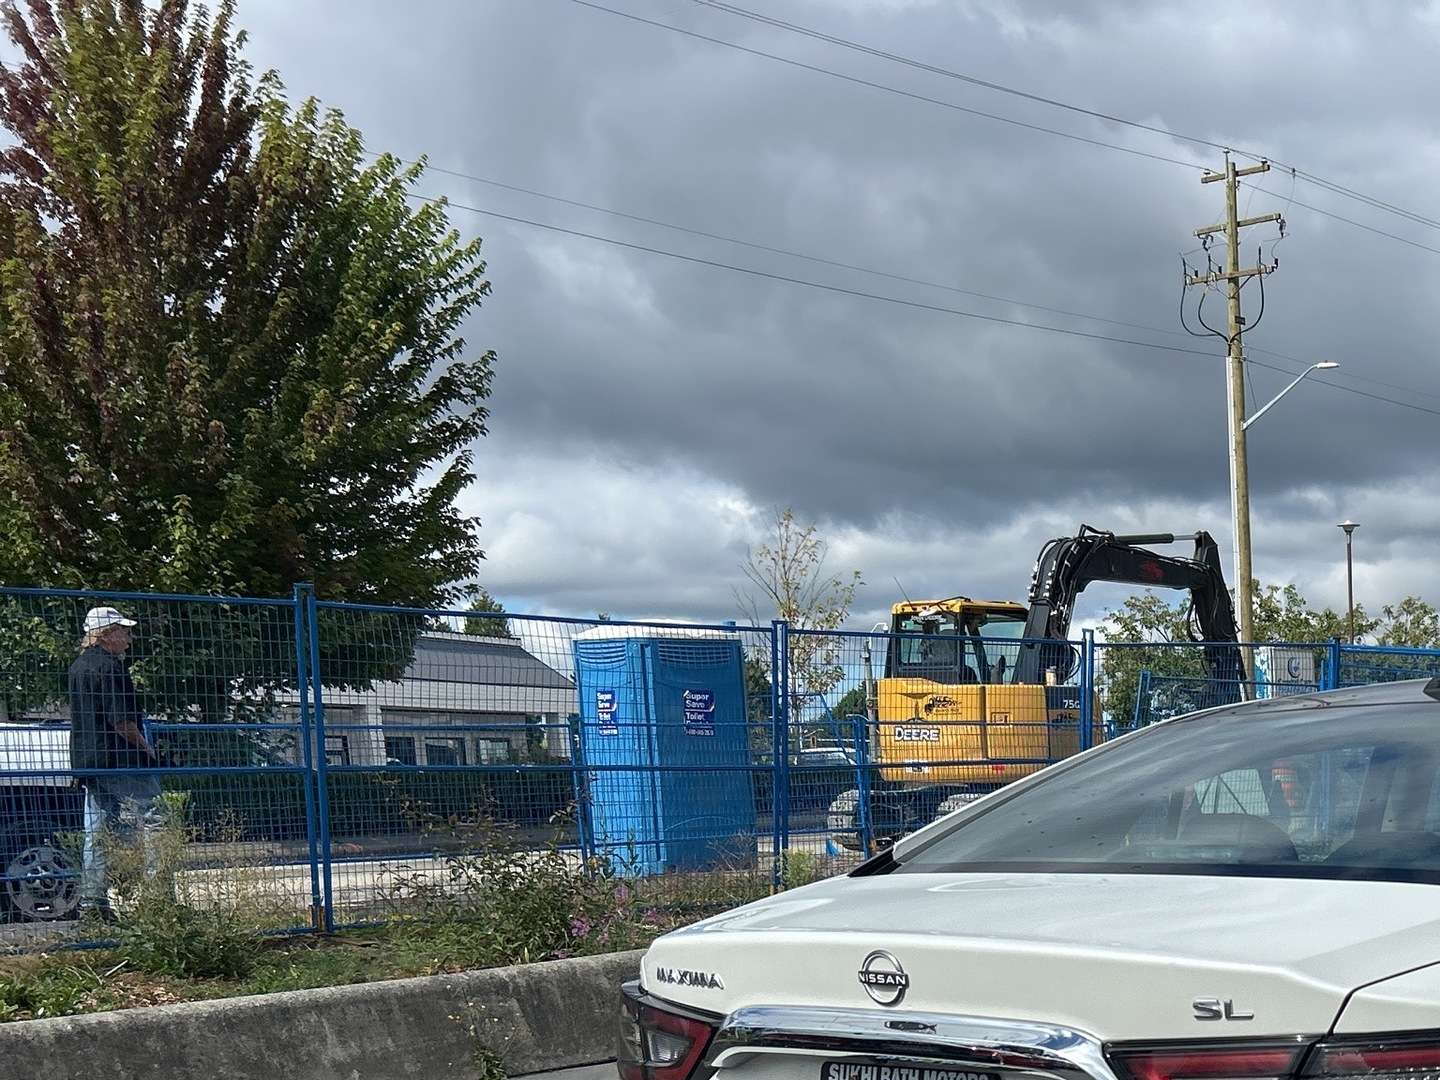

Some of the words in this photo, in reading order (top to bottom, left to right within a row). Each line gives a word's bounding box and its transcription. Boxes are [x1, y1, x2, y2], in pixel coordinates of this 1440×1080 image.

[685, 692, 710, 701] Super
[685, 700, 706, 708] Save
[894, 726, 940, 741] DEERE
[656, 966, 725, 990] MAXIMA
[858, 972, 906, 985] NISSAN
[1192, 998, 1255, 1021] SL
